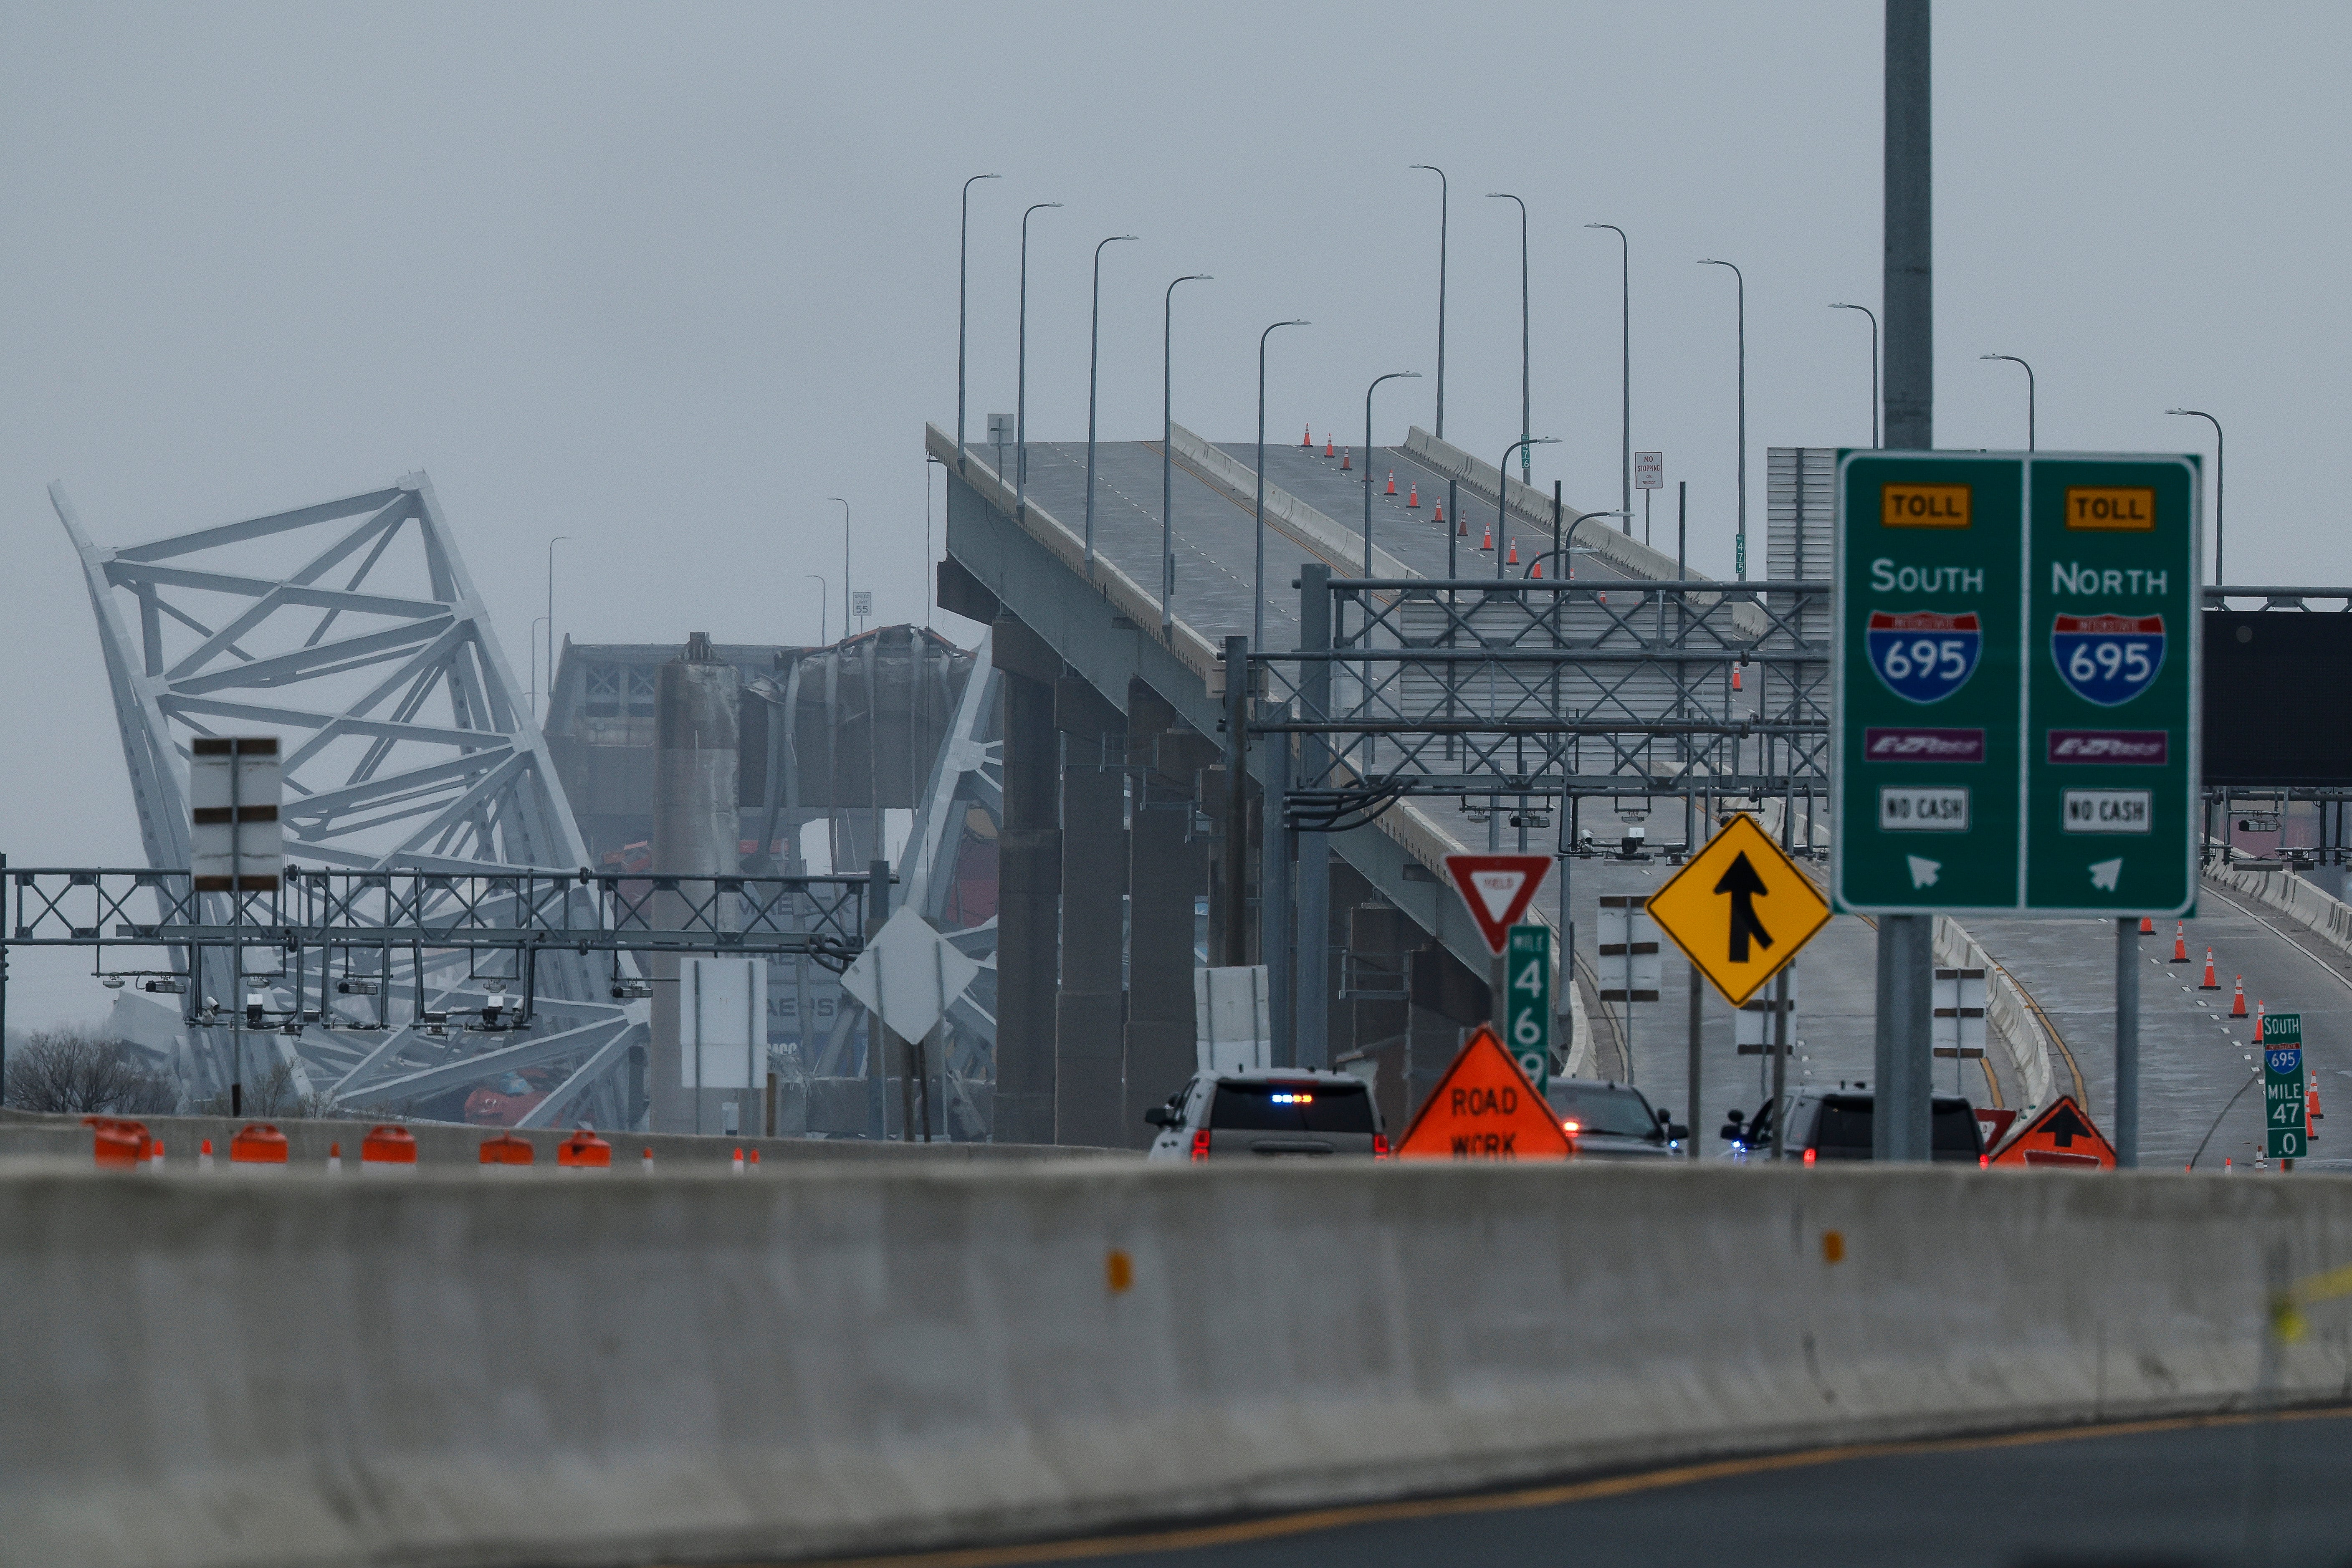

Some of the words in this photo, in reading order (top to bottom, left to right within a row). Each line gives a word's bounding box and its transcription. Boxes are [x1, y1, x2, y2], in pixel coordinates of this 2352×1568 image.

[1892, 494, 1962, 518] TOLL
[2076, 497, 2145, 520] TOLL
[1871, 557, 1984, 593] SOUTH
[2051, 561, 2168, 595] NORTH
[1884, 639, 1967, 681] 695
[2069, 642, 2152, 682] 695
[1886, 797, 1911, 819] NO
[1917, 797, 1963, 819] CASH
[2069, 800, 2093, 821] NO
[2099, 800, 2145, 822] CASH
[1484, 878, 1513, 890] YIELD
[1512, 934, 1544, 952] MILE
[2264, 1017, 2299, 1035] SOUTH
[2271, 1051, 2296, 1067] 695
[1452, 1085, 1518, 1117] ROAD
[2268, 1082, 2301, 1100] MILE
[2272, 1102, 2300, 1123] 47
[1450, 1132, 1517, 1161] WORK
[2278, 1133, 2297, 1154] .0
